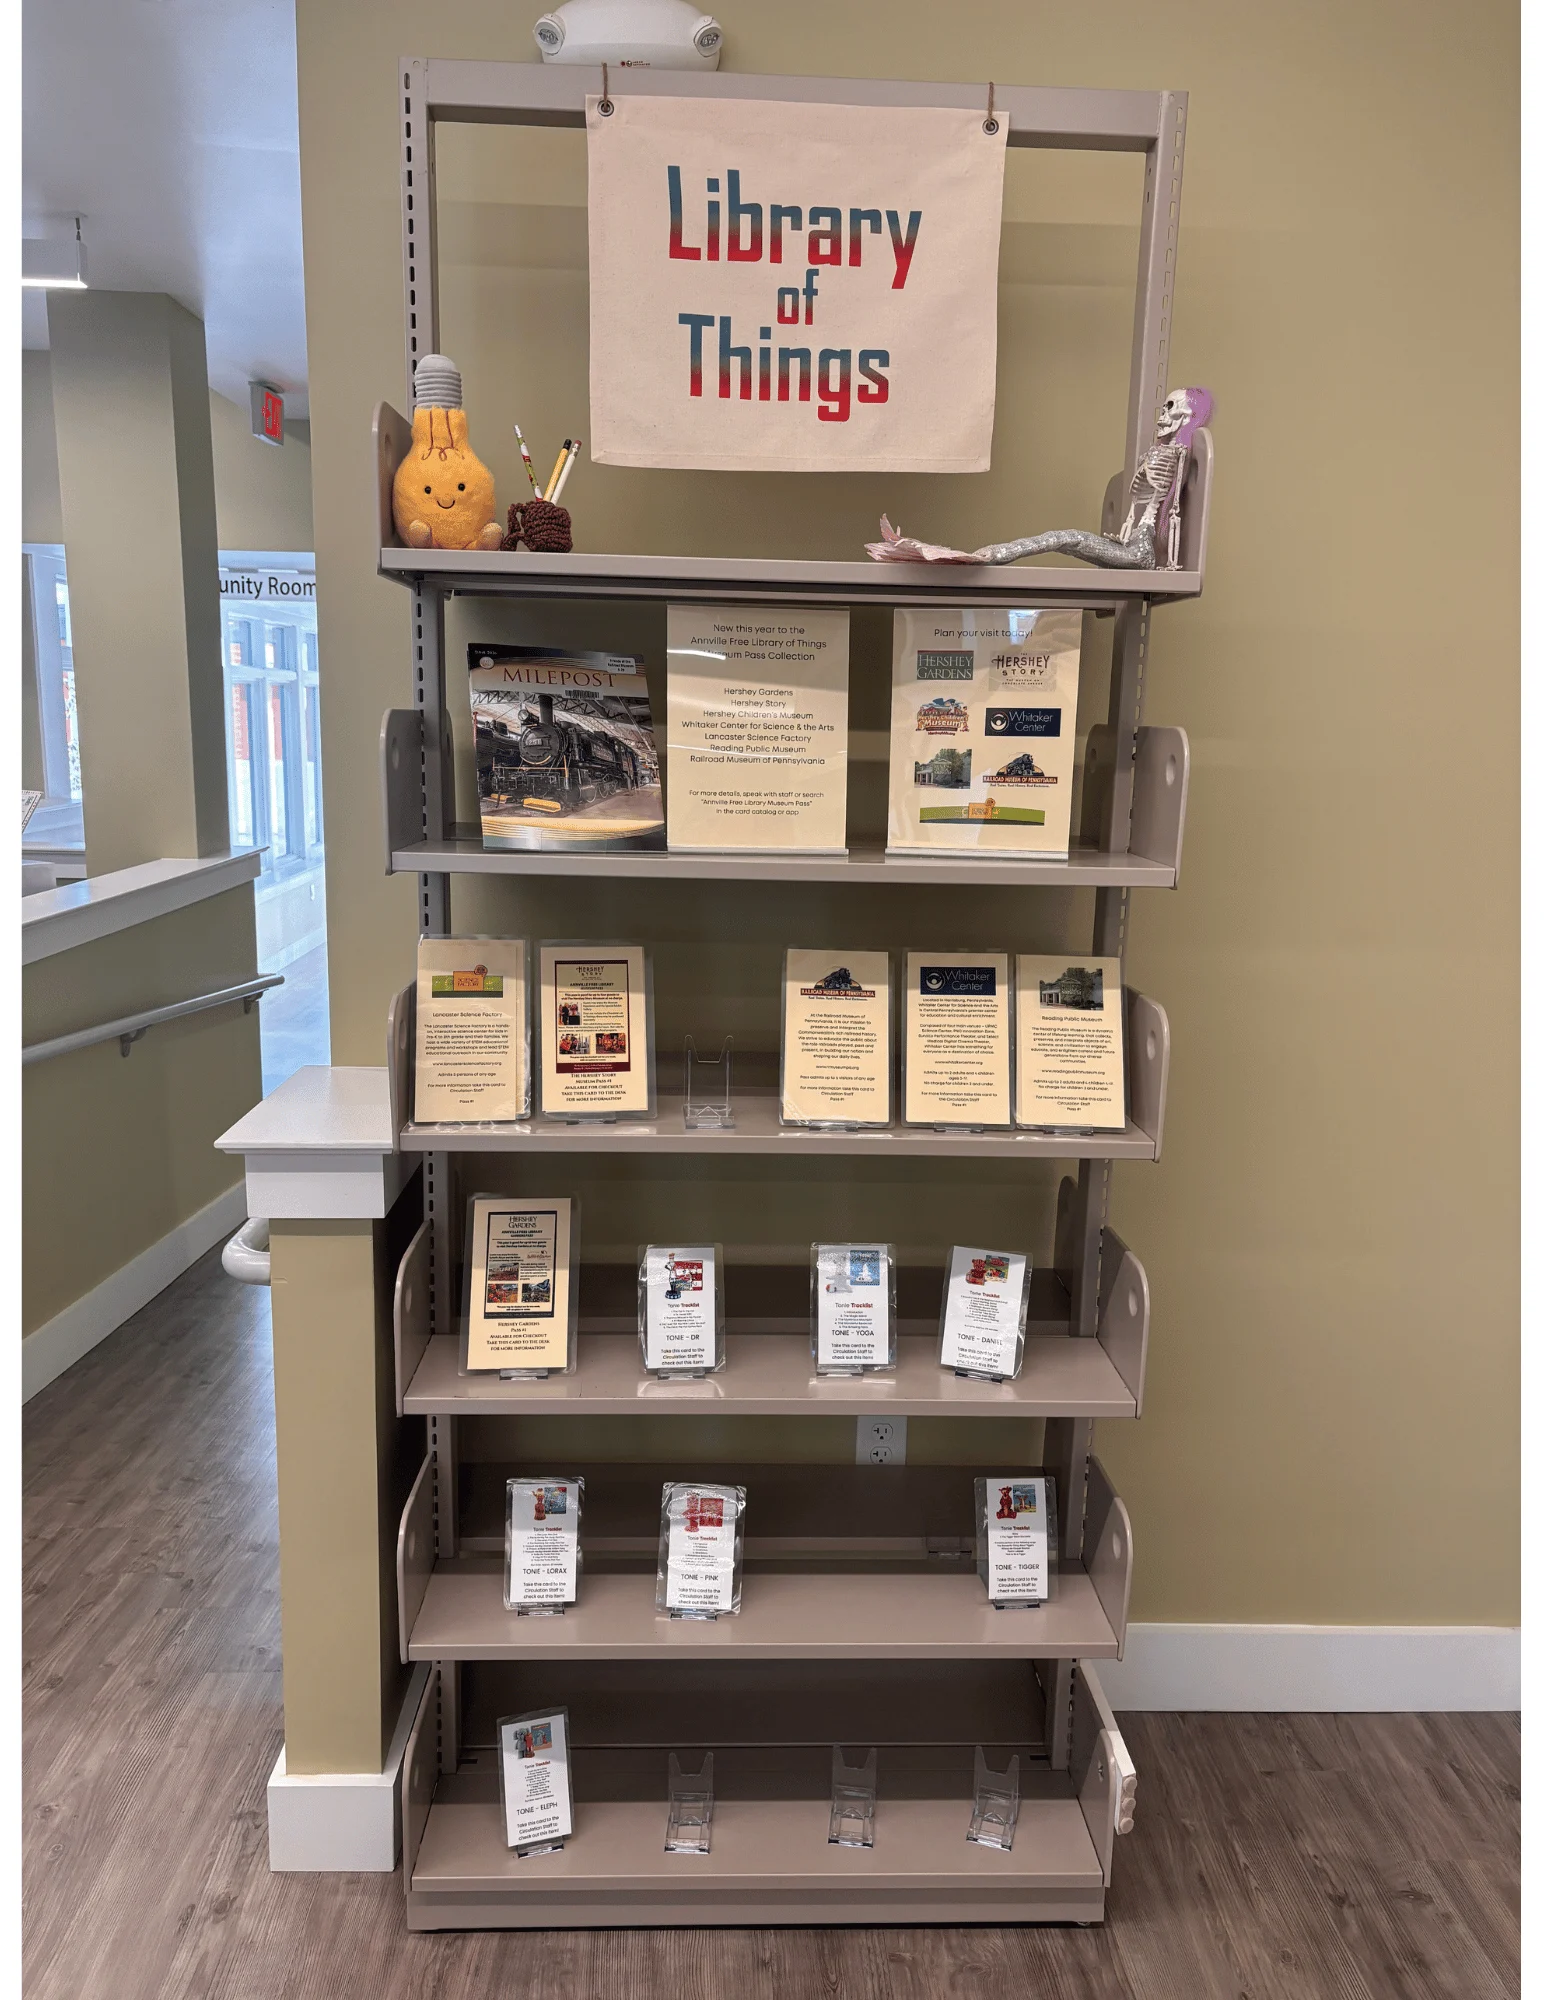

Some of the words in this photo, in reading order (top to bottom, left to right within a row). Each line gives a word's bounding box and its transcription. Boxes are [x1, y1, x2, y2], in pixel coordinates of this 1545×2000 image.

[667, 165, 922, 290] Library
[777, 268, 818, 325] of
[678, 312, 890, 422] Things
[268, 576, 316, 596] Room
[736, 624, 752, 632] this
[789, 626, 804, 634] the
[934, 628, 954, 636] Plan
[956, 630, 978, 638] your
[980, 628, 999, 637] visit
[1002, 628, 1032, 639] today!
[690, 636, 726, 645] Annville
[729, 637, 749, 645] Free
[751, 638, 783, 648] Library
[785, 638, 795, 647] of
[796, 639, 826, 649] Things
[704, 650, 742, 659] eum
[744, 651, 765, 659] Pass
[768, 652, 814, 660] Collection
[919, 654, 973, 667] HERSHEY
[992, 655, 1050, 669] HERSHEY
[503, 668, 616, 688] MILEPOST
[917, 667, 972, 679] GARDENS
[724, 688, 756, 696] Hershey
[731, 699, 756, 708] Hershey
[765, 699, 786, 708] Story
[703, 710, 736, 719] Hershey
[1009, 711, 1053, 722] Whitaker
[1015, 722, 1046, 731] Center
[780, 734, 811, 743] Factory
[710, 744, 743, 753] Reading
[772, 757, 824, 765] Pennsylvania
[945, 970, 990, 981] Whitaker
[952, 981, 983, 990] Center
[958, 1333, 974, 1341] TONIE
[516, 1806, 534, 1815] TONIE
[540, 1802, 557, 1810] ELEPH
